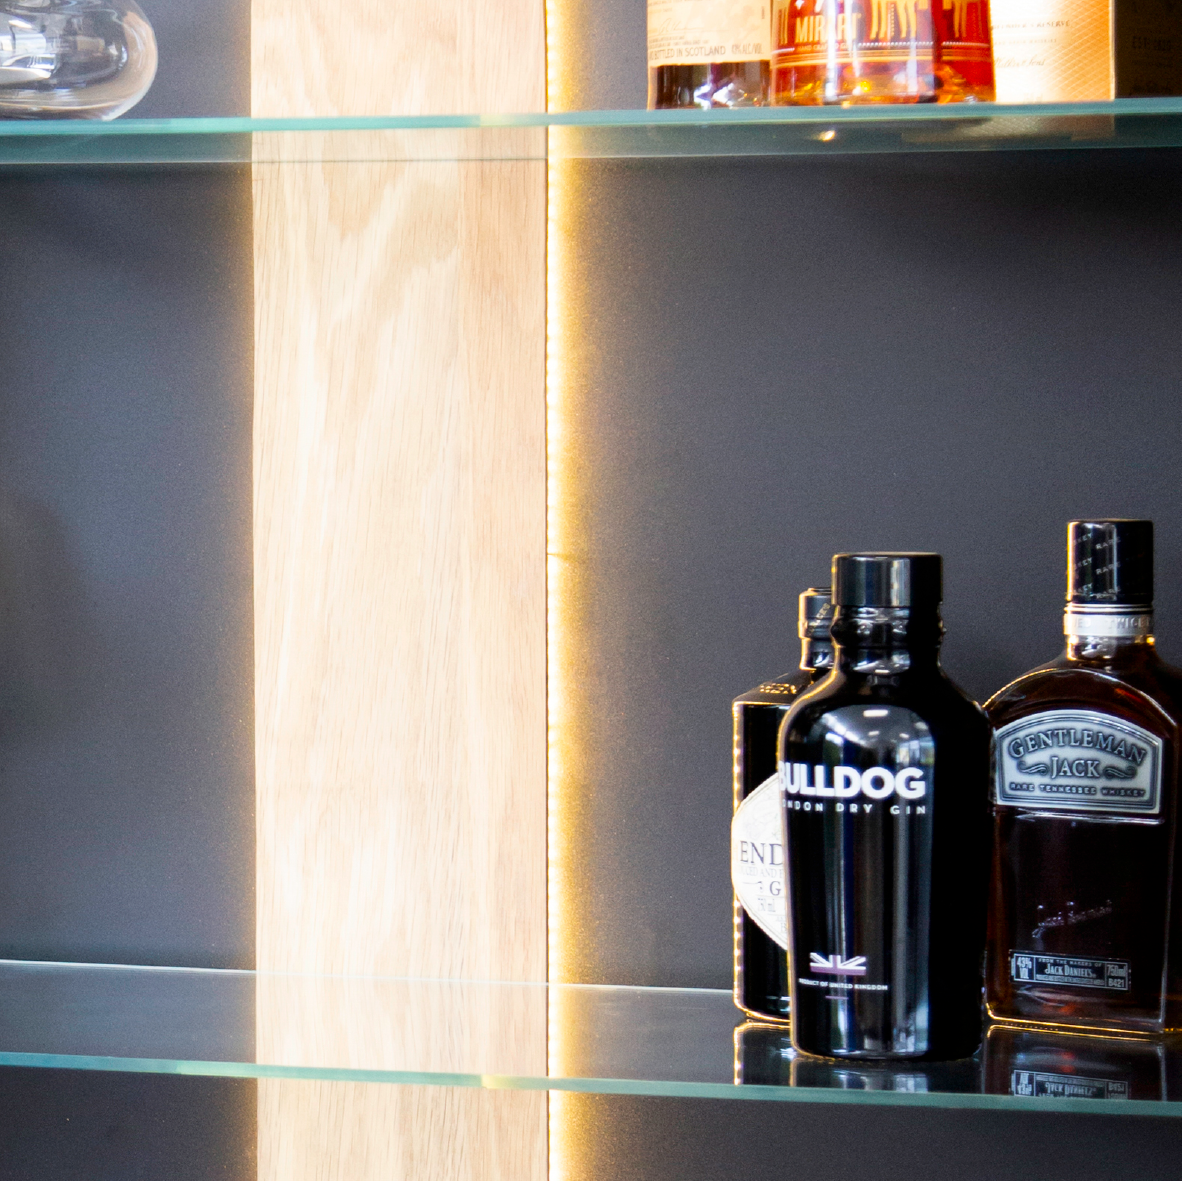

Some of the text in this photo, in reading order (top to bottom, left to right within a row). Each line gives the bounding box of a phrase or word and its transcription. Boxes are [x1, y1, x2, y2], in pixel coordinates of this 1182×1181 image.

[685, 46, 726, 57] SCOTLAND
[1008, 728, 1147, 765] GENTLEMAN
[1051, 756, 1100, 779] JACK
[778, 760, 926, 799] BULLDOG
[1010, 782, 1147, 797] RARE TENNESSEE WHISKEY
[835, 802, 873, 814] DRY
[890, 805, 926, 815] GIN
[1044, 963, 1064, 976] JACK
[829, 981, 854, 989] UNITED
